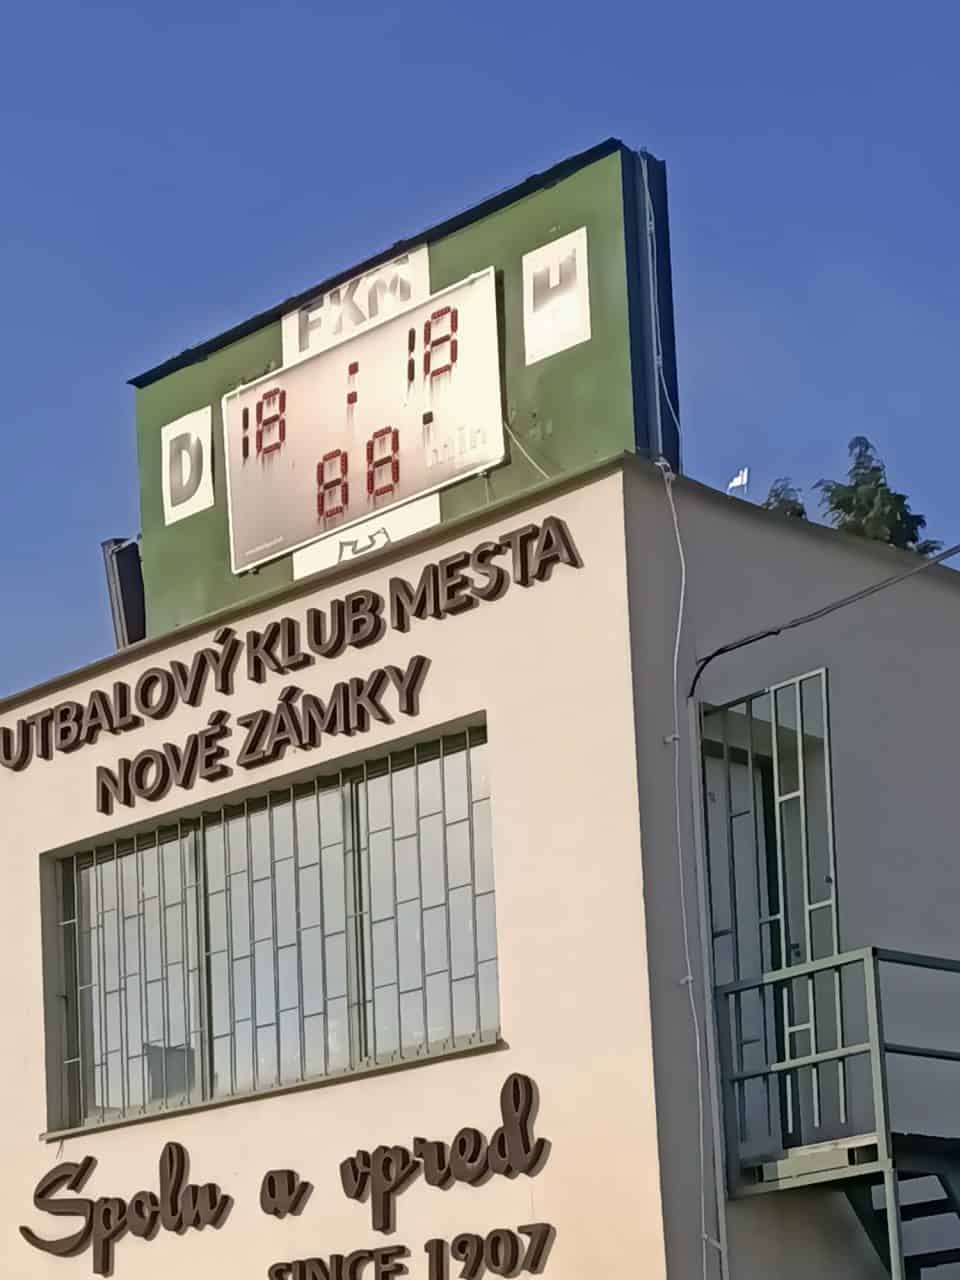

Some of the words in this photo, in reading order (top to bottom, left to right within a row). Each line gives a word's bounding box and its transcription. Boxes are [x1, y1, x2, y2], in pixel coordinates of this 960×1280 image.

[170, 431, 204, 508] D
[246, 588, 384, 682] KLUB
[389, 516, 584, 632] MESTA
[96, 709, 234, 814] NOVÉ
[236, 655, 432, 768] ZÁMKY
[19, 1141, 234, 1278] Spolu
[259, 1168, 314, 1219] a
[339, 1072, 552, 1235] vpred
